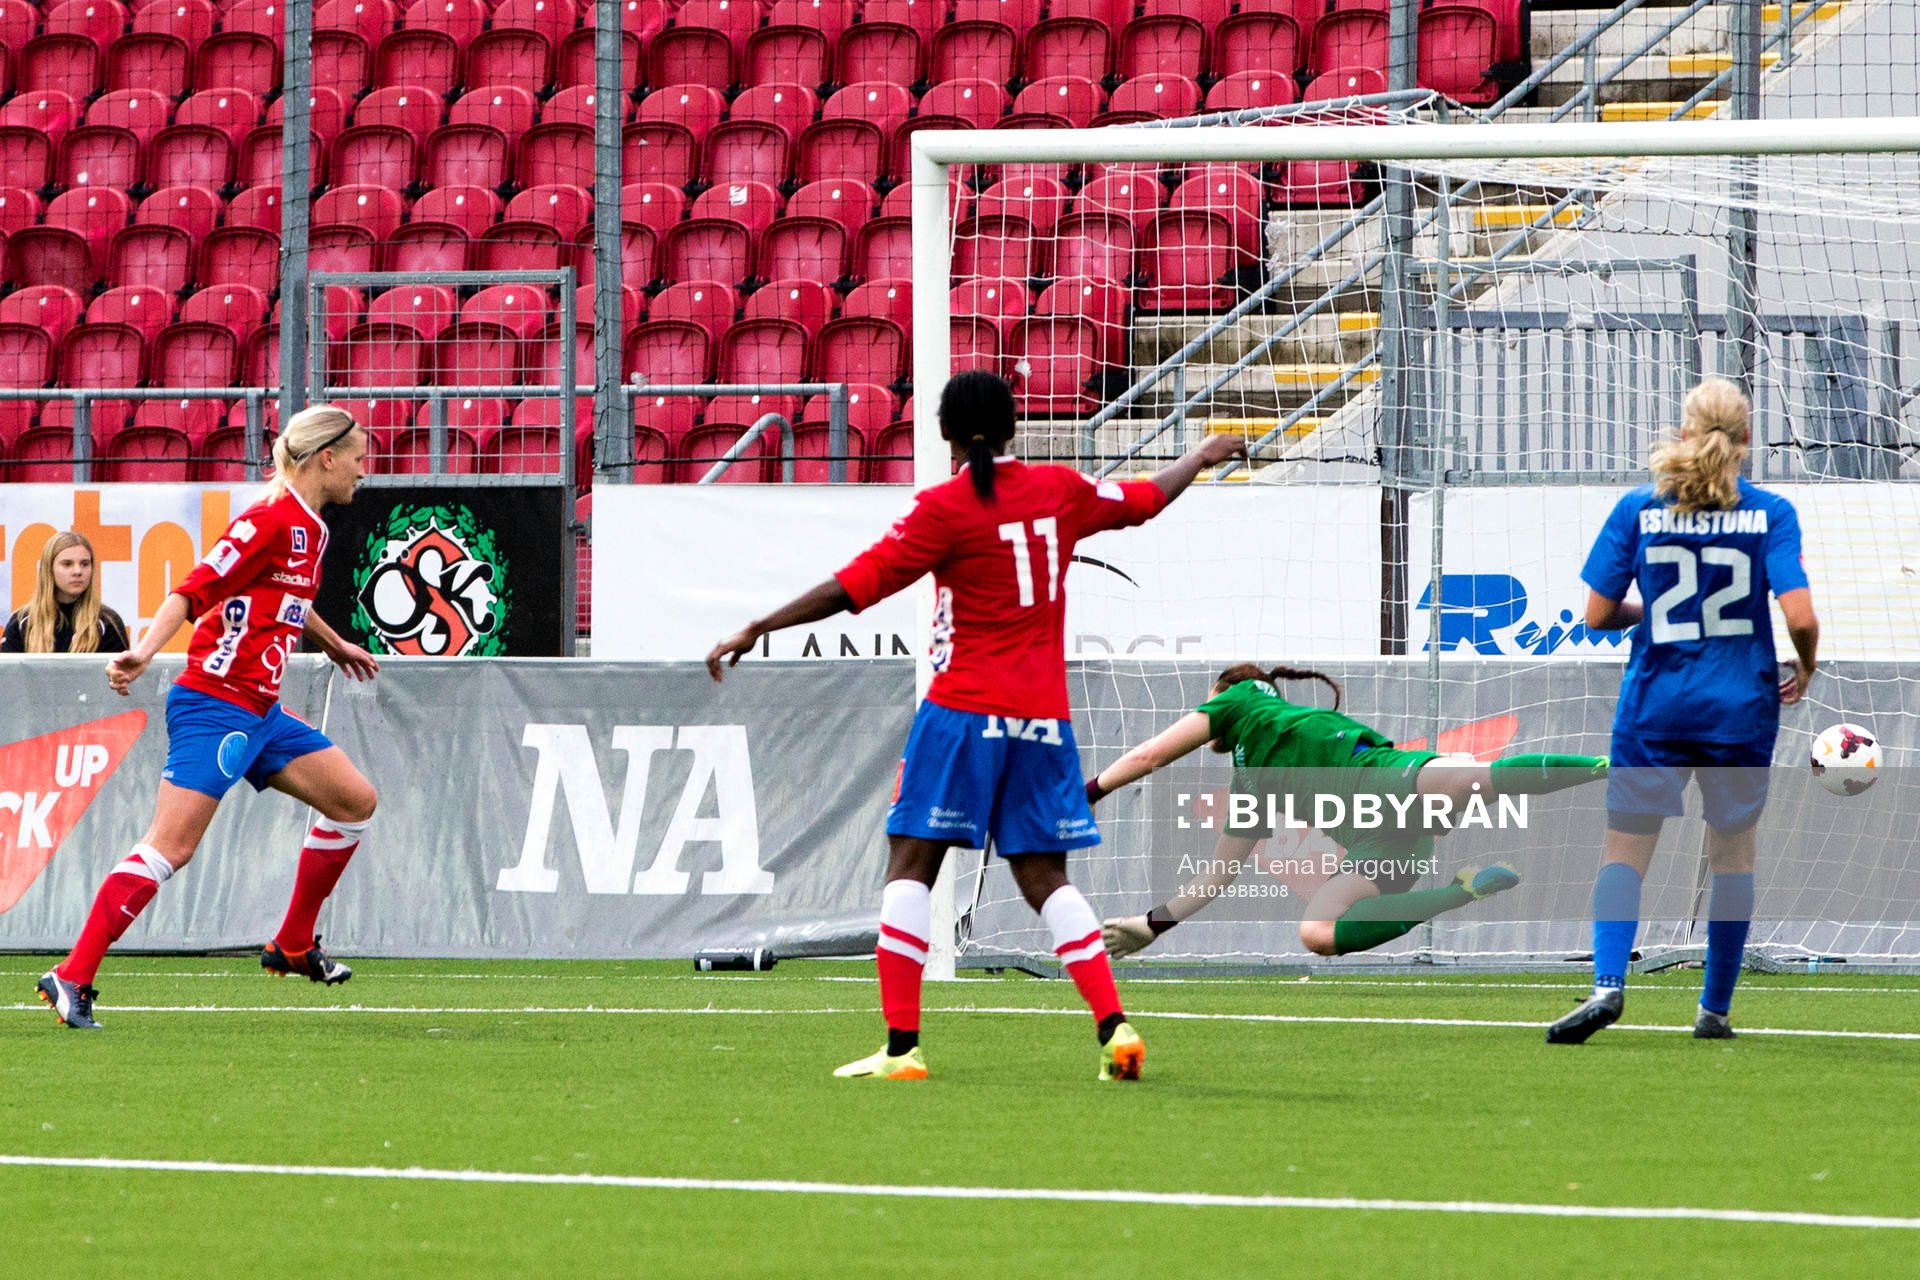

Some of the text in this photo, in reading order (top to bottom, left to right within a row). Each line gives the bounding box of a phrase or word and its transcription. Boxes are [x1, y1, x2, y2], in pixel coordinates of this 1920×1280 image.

[998, 516, 1059, 607] 11
[1639, 508, 1768, 535] ESKILSTUNA
[1645, 545, 1754, 644] 22
[55, 744, 109, 788] UP
[496, 723, 775, 894] NA
